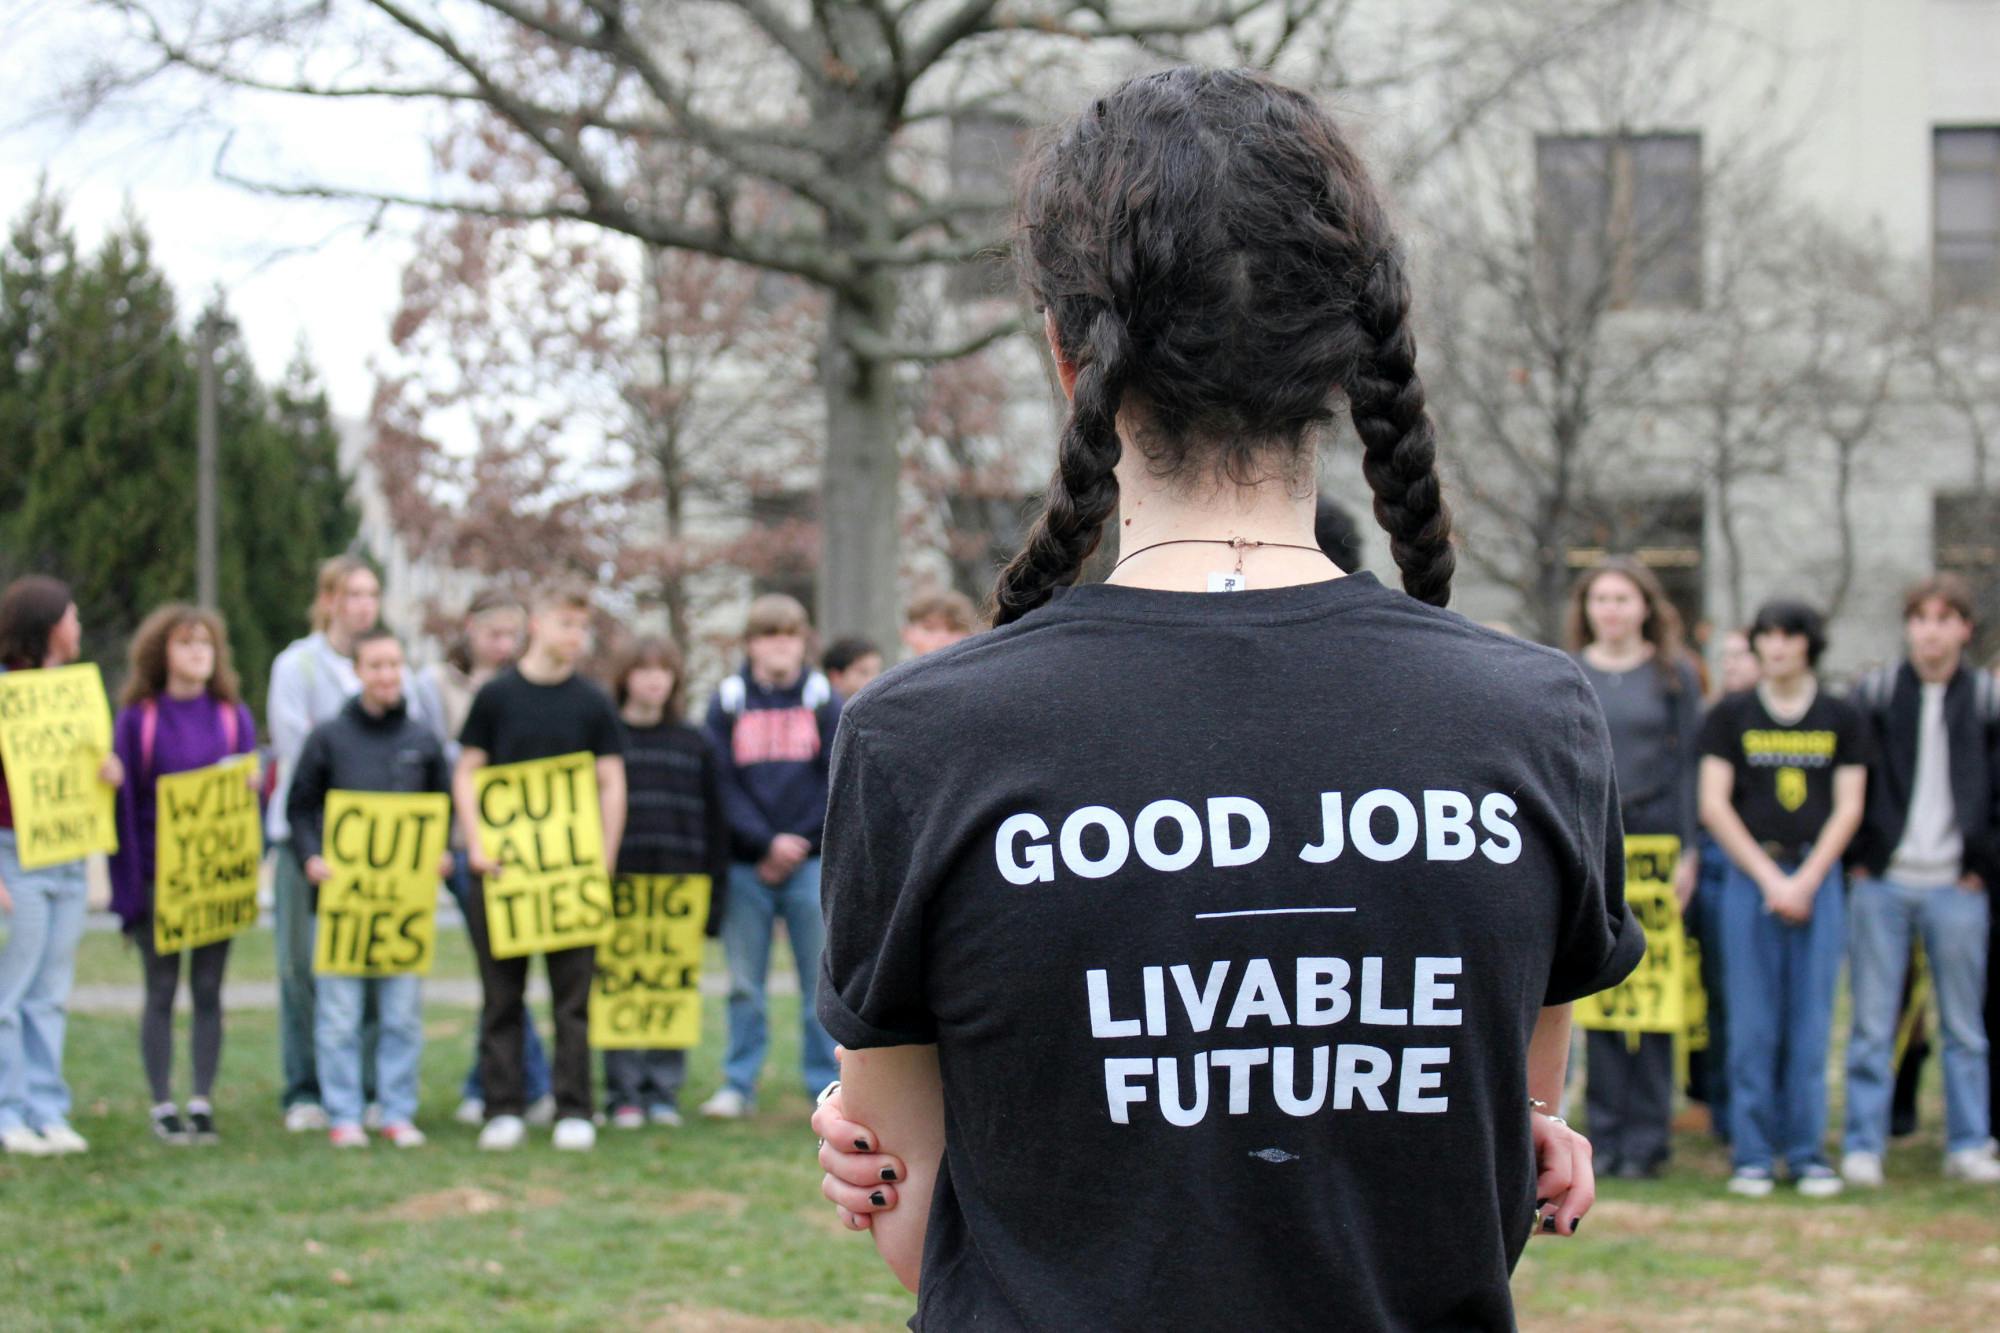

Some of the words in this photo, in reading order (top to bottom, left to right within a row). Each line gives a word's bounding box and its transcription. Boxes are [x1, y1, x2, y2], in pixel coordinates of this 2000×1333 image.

[480, 766, 584, 829] CUT
[174, 822, 246, 874] YOU
[331, 807, 437, 872] CUT
[499, 826, 594, 874] ALL
[995, 796, 1271, 885] GOOD
[1299, 788, 1522, 864] JOBS
[342, 880, 400, 900] ALL
[495, 874, 614, 940] TIES
[614, 876, 692, 919] BIG
[325, 909, 427, 968] TIES
[610, 926, 679, 959] OIL
[1086, 956, 1463, 1038] LIVABLE
[1104, 1044, 1451, 1128] FUTURE
